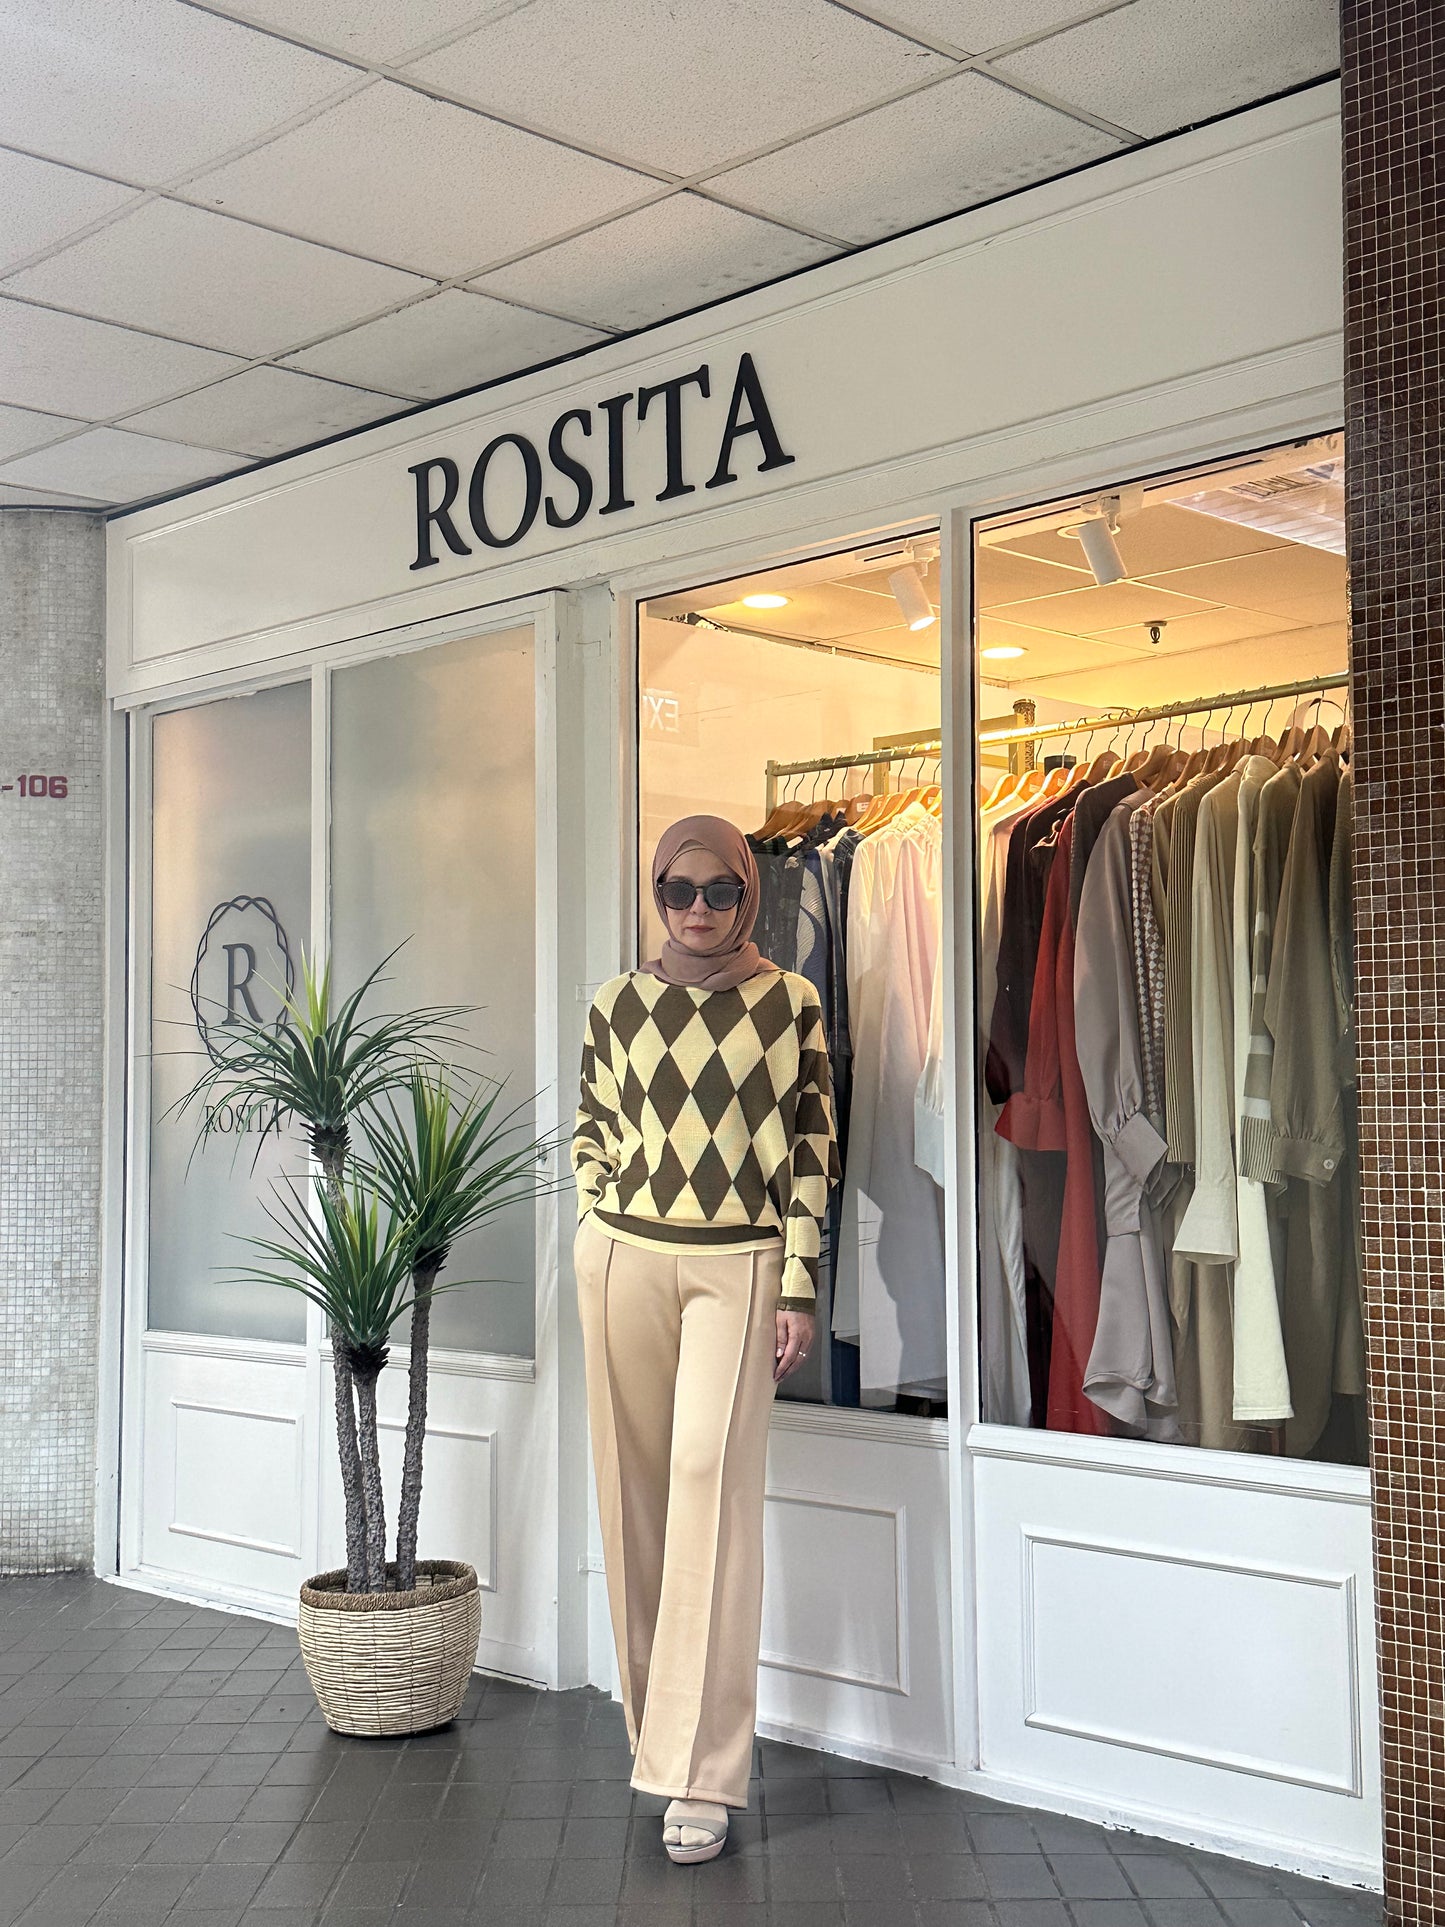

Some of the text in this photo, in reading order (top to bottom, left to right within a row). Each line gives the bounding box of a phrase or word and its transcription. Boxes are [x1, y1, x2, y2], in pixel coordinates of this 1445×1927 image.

[408, 352, 795, 570] ROSITA
[222, 943, 263, 1025] R
[205, 1104, 283, 1133] ROSITA
